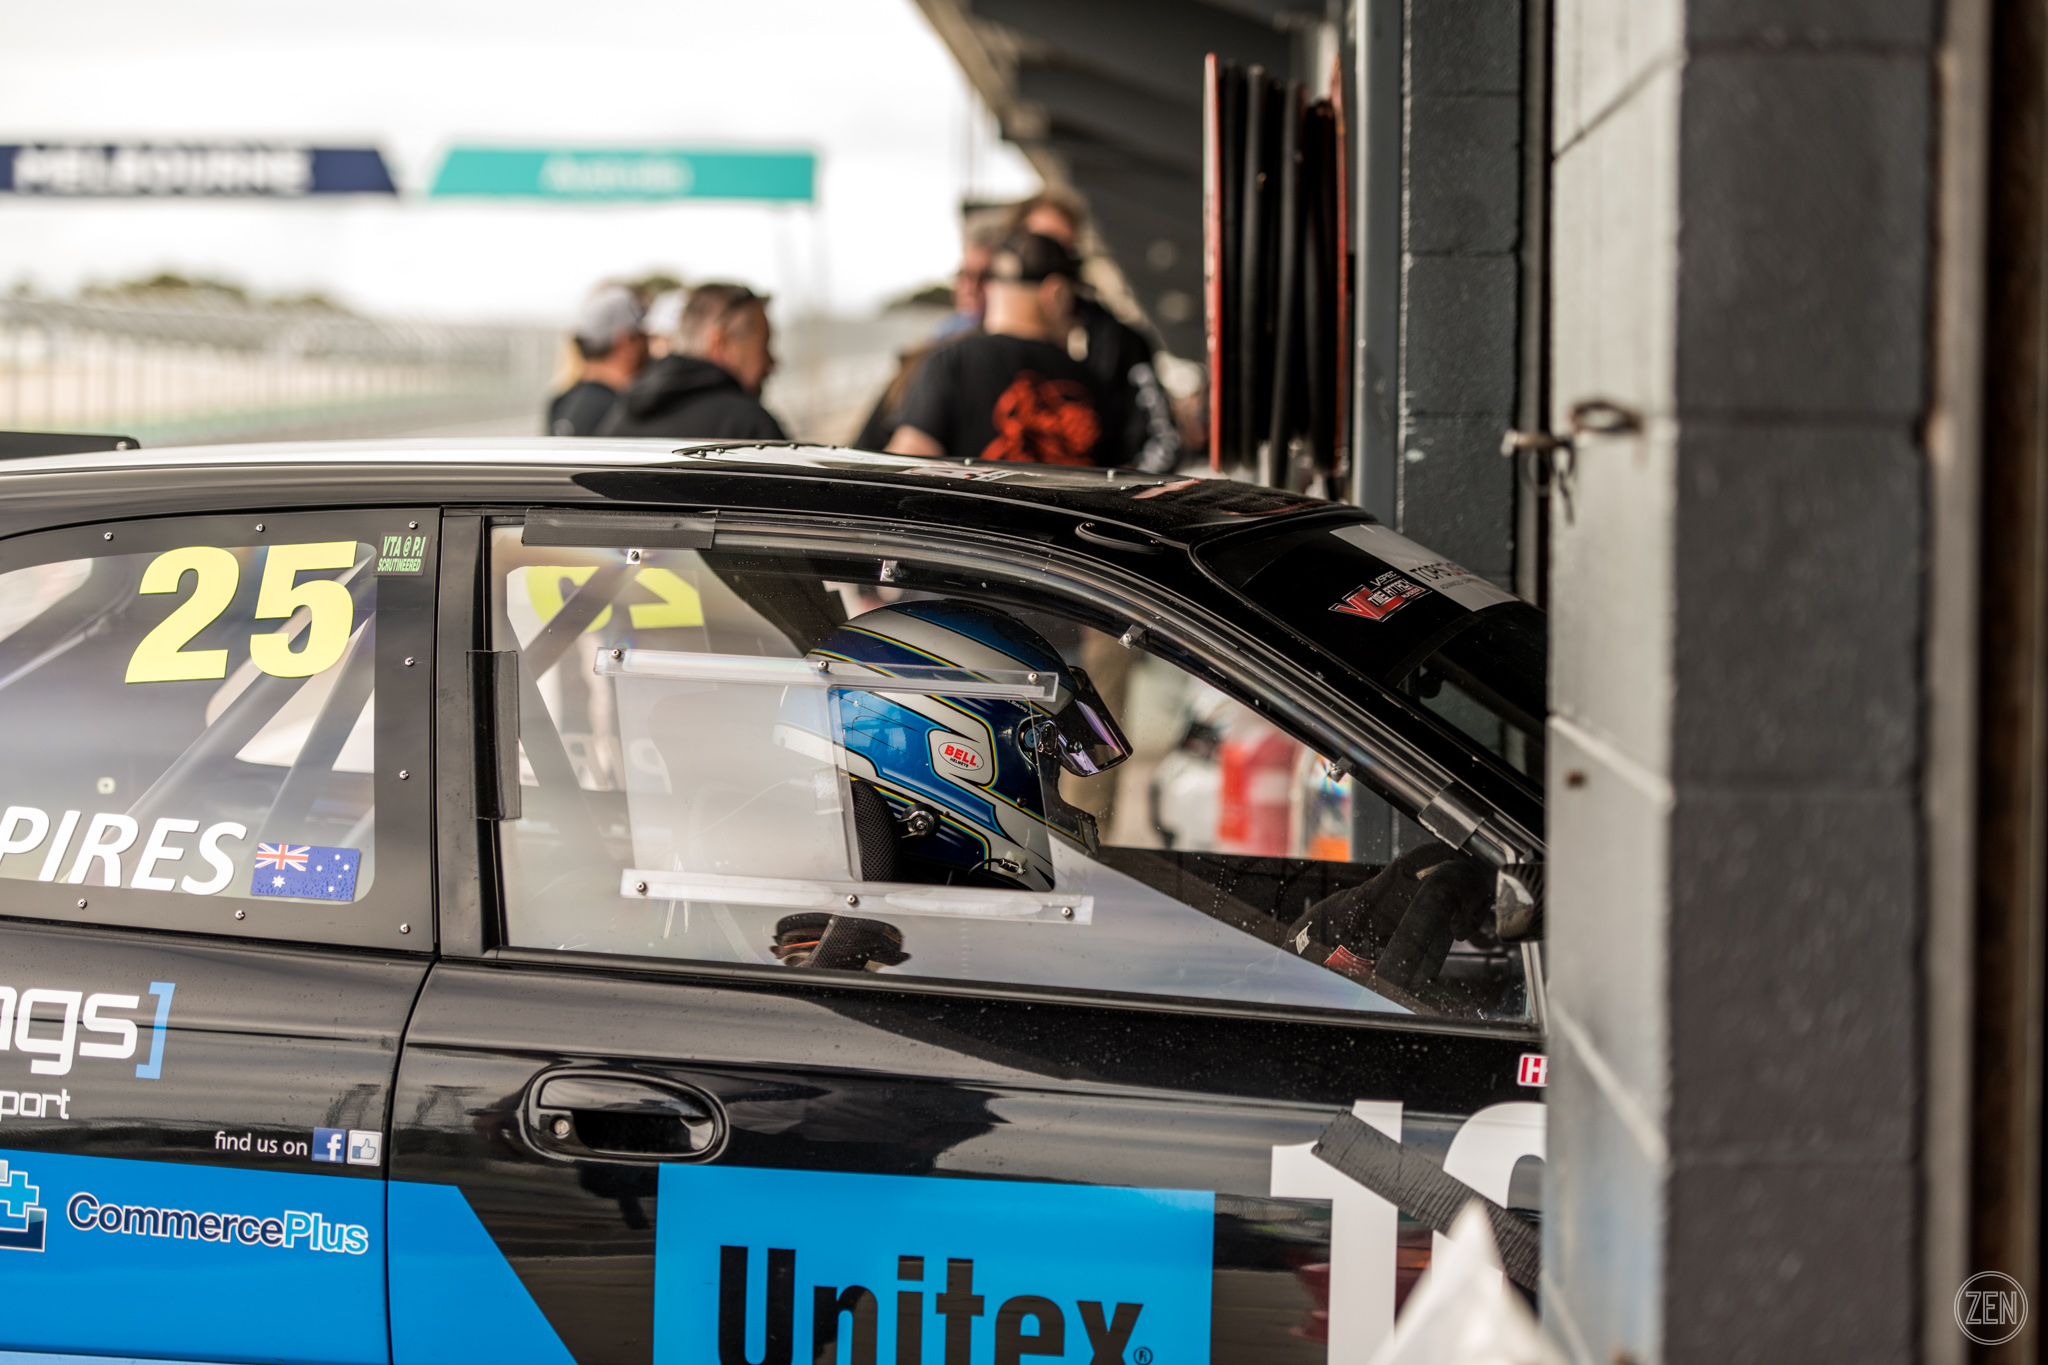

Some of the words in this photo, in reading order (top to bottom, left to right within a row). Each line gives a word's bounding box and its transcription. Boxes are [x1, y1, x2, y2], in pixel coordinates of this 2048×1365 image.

[382, 536, 402, 557] VTA
[377, 558, 422, 572] SCRUTINEERED
[1367, 591, 1390, 606] TIME
[1382, 578, 1411, 597] ATTACK
[125, 540, 358, 684] 25
[944, 744, 978, 767] BELL
[949, 757, 969, 768] HELMETS
[0, 806, 247, 895] PIRES
[214, 1131, 252, 1151] find
[257, 1139, 278, 1153] us
[283, 1141, 308, 1156] on
[66, 1191, 369, 1255] CommercePlus
